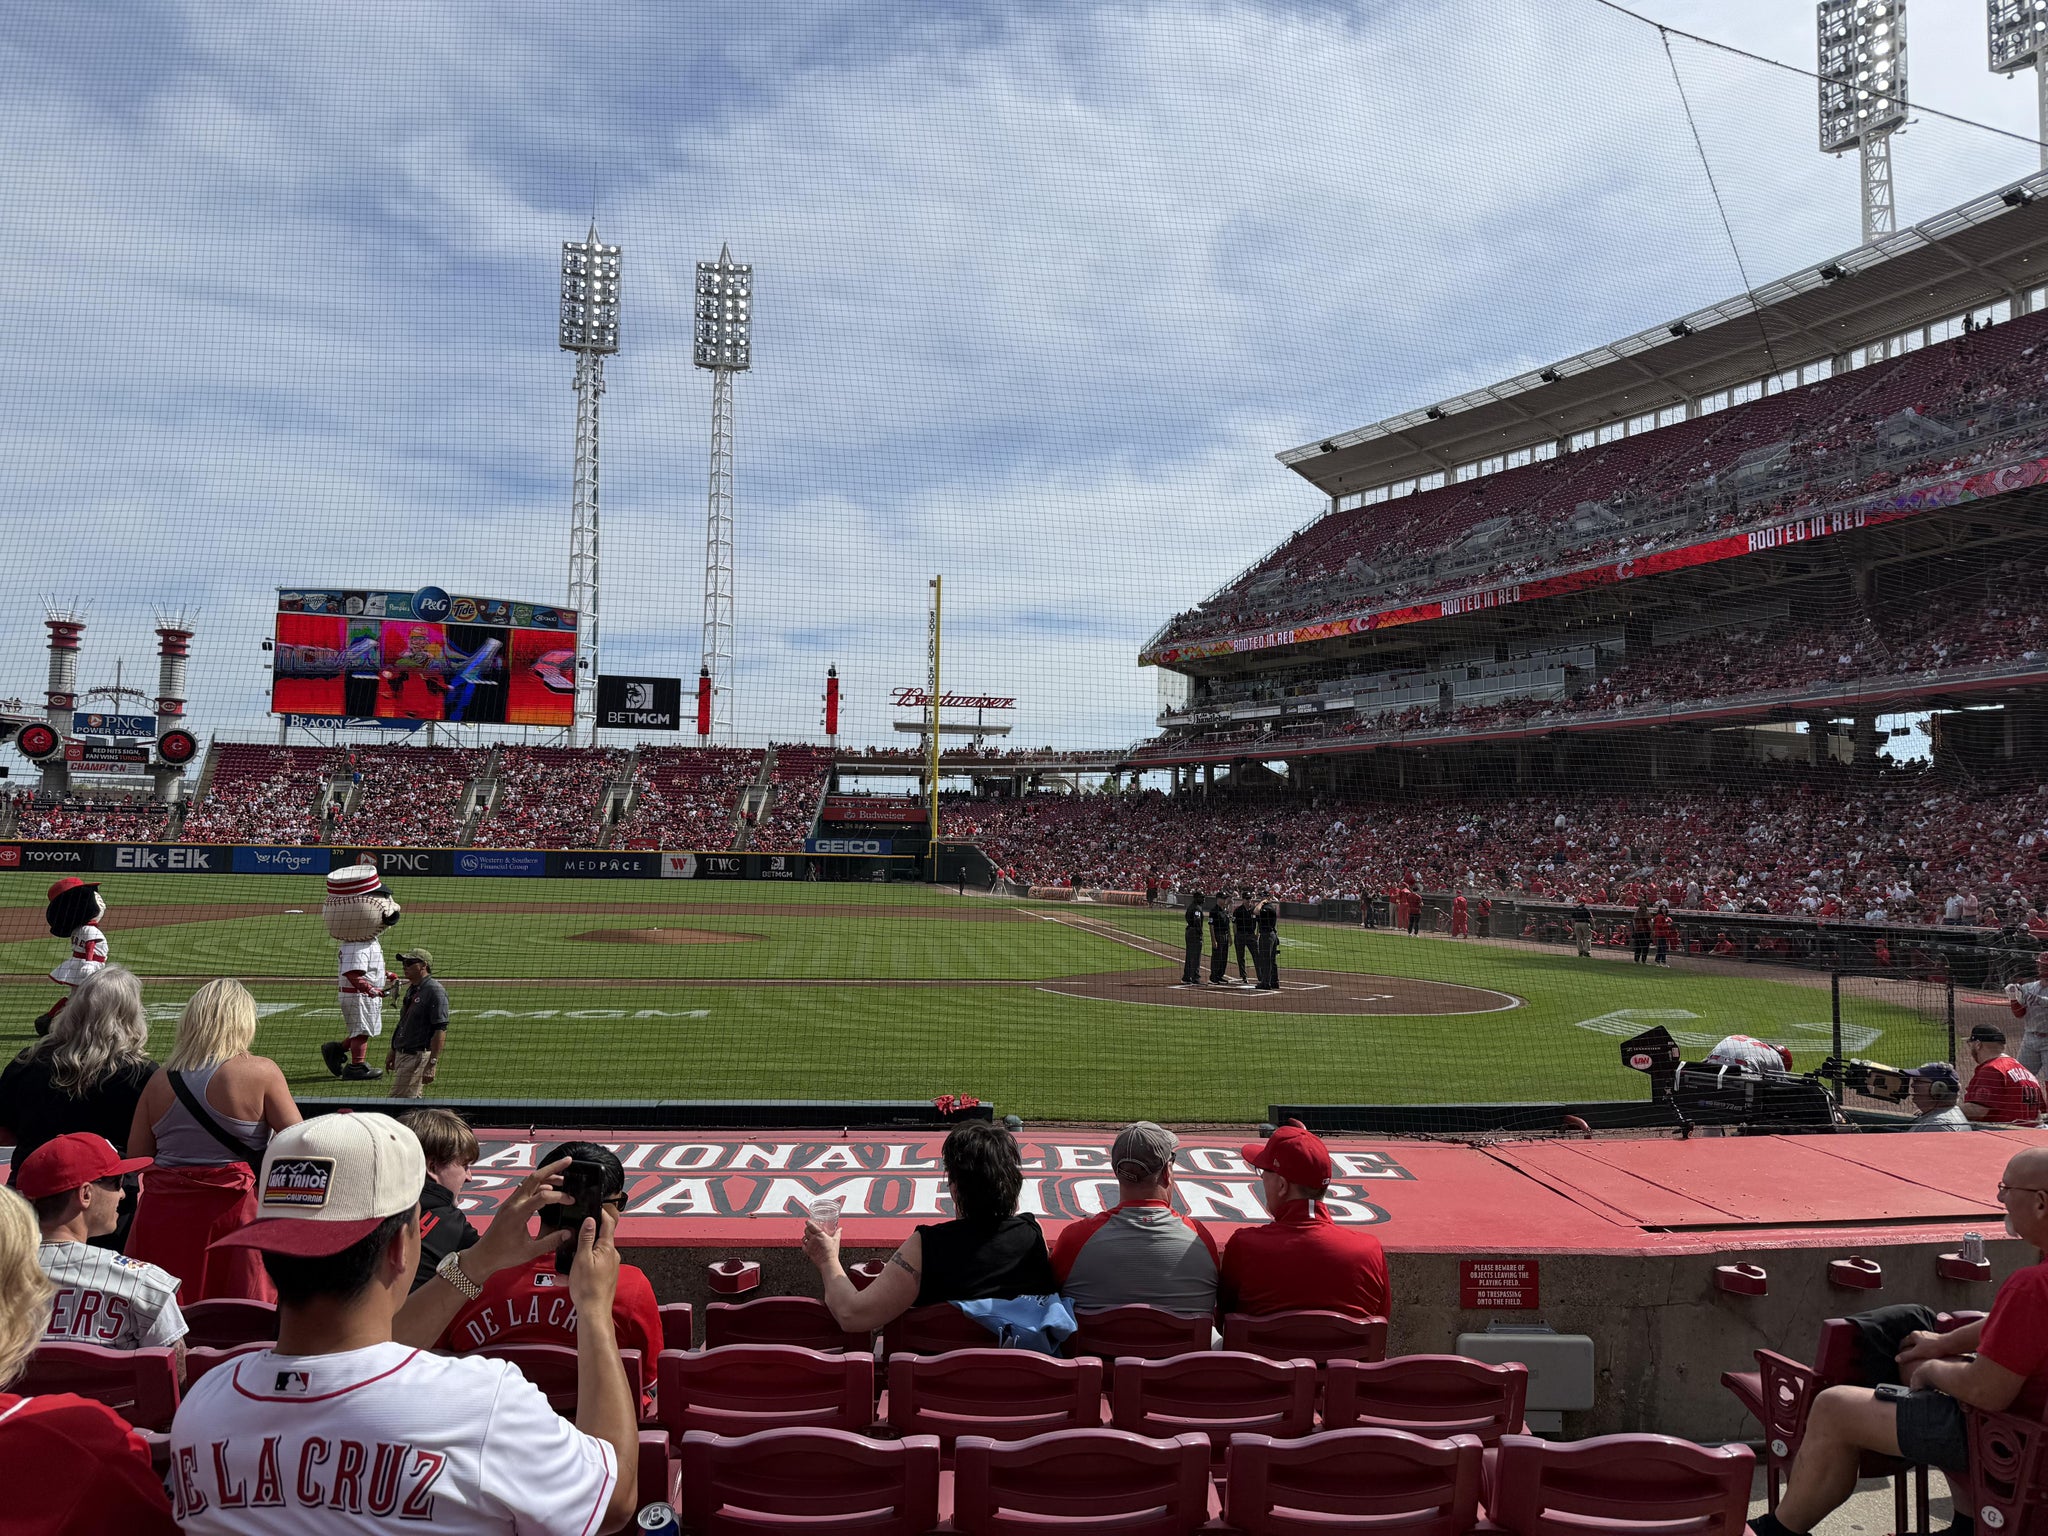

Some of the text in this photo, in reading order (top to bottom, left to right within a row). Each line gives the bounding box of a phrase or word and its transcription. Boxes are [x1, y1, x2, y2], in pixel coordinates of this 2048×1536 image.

[1748, 521, 1805, 552] ROOTED
[1832, 509, 1865, 532] RED
[420, 598, 447, 612] P&G
[1441, 594, 1481, 617] ROOTED
[1498, 586, 1520, 605] RED
[453, 603, 475, 617] Tide
[1233, 637, 1264, 653] ROOTED
[1277, 631, 1294, 645] RED
[88, 685, 145, 697] CINCINNATI
[104, 716, 143, 730] PNC
[291, 715, 343, 729] BEACON
[608, 711, 670, 725] BETMGM
[76, 727, 152, 737] POWER STACKS
[70, 762, 127, 773] CHAMPION
[859, 811, 907, 820] Budweiser
[815, 840, 880, 853] GEICO
[26, 851, 81, 862] TOYOTA
[116, 847, 210, 868] Elk+Elk
[272, 850, 311, 871] Kroger
[381, 853, 429, 871] PNC
[480, 856, 503, 864] Western
[509, 863, 529, 871] Group
[706, 858, 740, 871] TWC
[468, 1142, 1406, 1180] AIONAL EGE
[268, 1173, 327, 1188] LAKE TAHOE
[286, 1193, 323, 1203] CALIFORNIA
[46, 1287, 131, 1341] ERS
[466, 1295, 577, 1346] DE LA CR
[211, 1434, 286, 1509] LA
[296, 1435, 448, 1521] CRUZ
[1988, 1511, 1997, 1522] G
